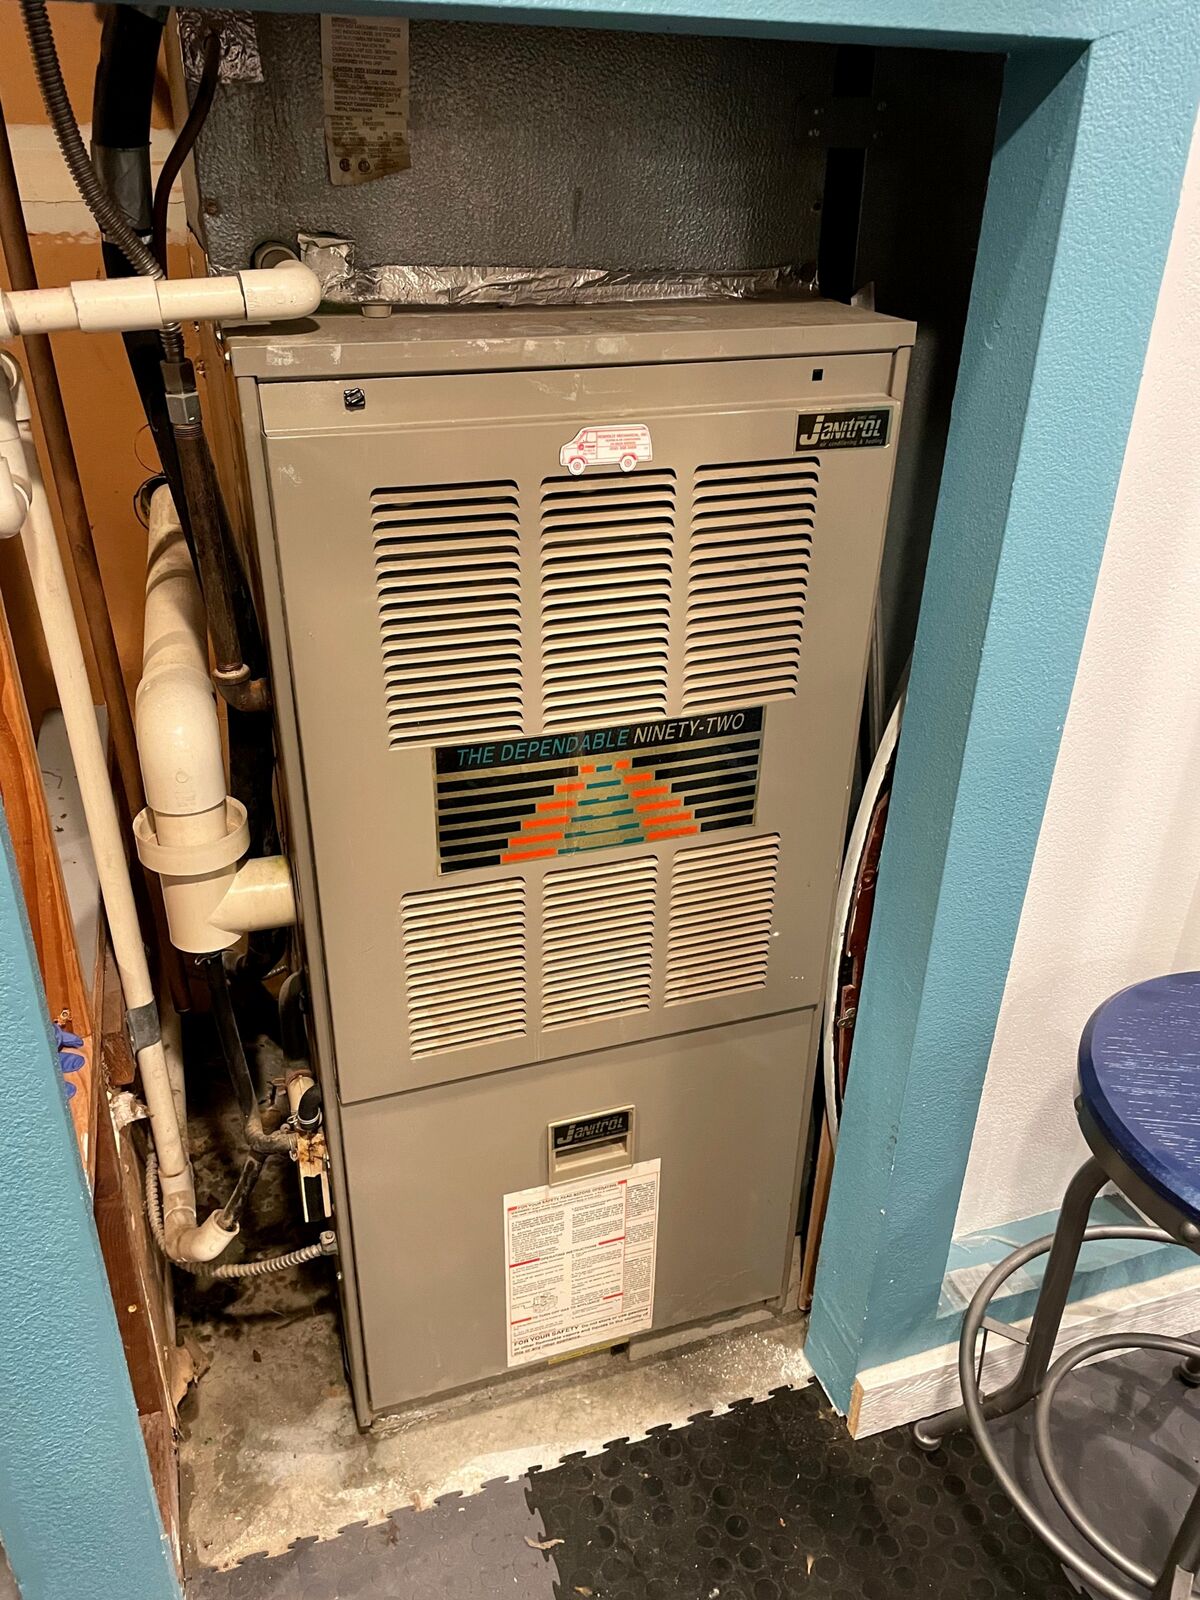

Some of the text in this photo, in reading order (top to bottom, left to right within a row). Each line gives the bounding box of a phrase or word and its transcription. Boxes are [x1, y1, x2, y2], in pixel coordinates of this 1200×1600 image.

[457, 713, 745, 766] THE DEPENDABLE NINETY-TWO
[530, 1333, 550, 1342] YOUR
[551, 1326, 579, 1336] SAFETY
